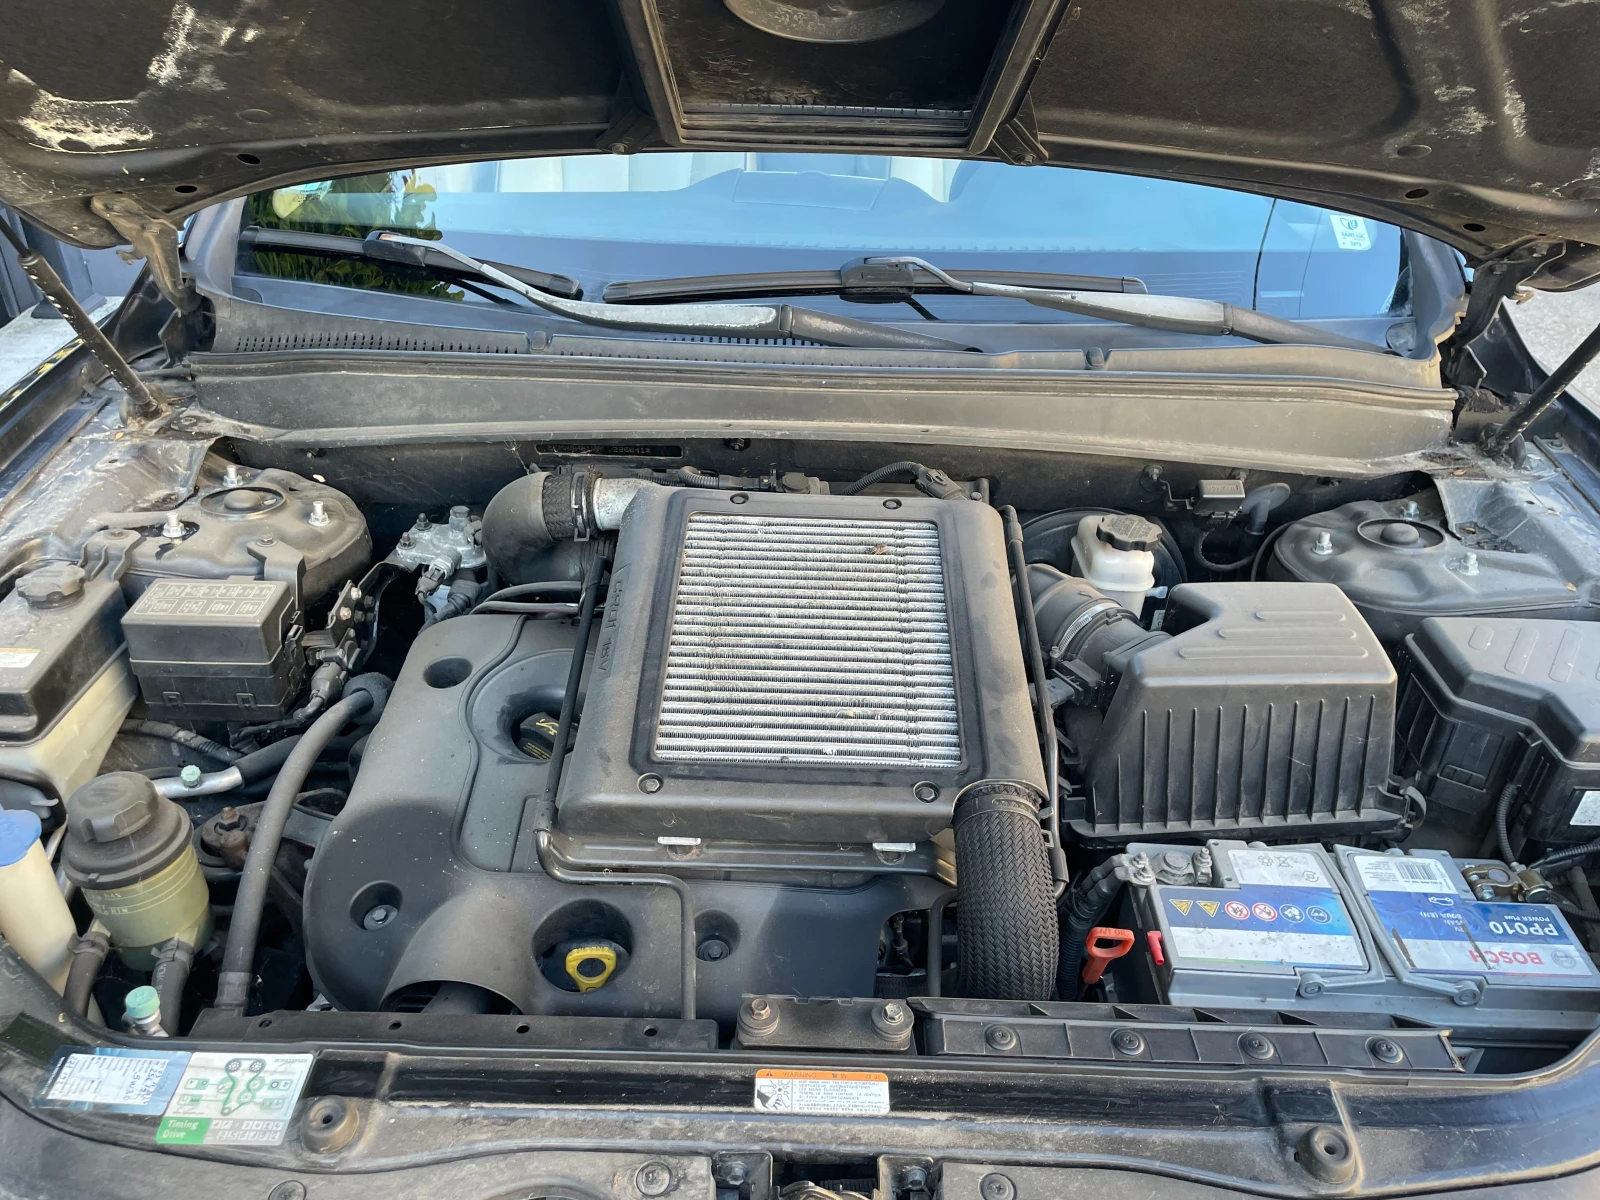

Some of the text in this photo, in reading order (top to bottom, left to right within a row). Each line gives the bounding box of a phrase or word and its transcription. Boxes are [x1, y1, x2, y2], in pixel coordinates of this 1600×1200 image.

[1489, 920, 1559, 936] PP010
[1469, 949, 1544, 965] BOSCH
[167, 1119, 199, 1130] Timing
[162, 1130, 187, 1138] Drive
